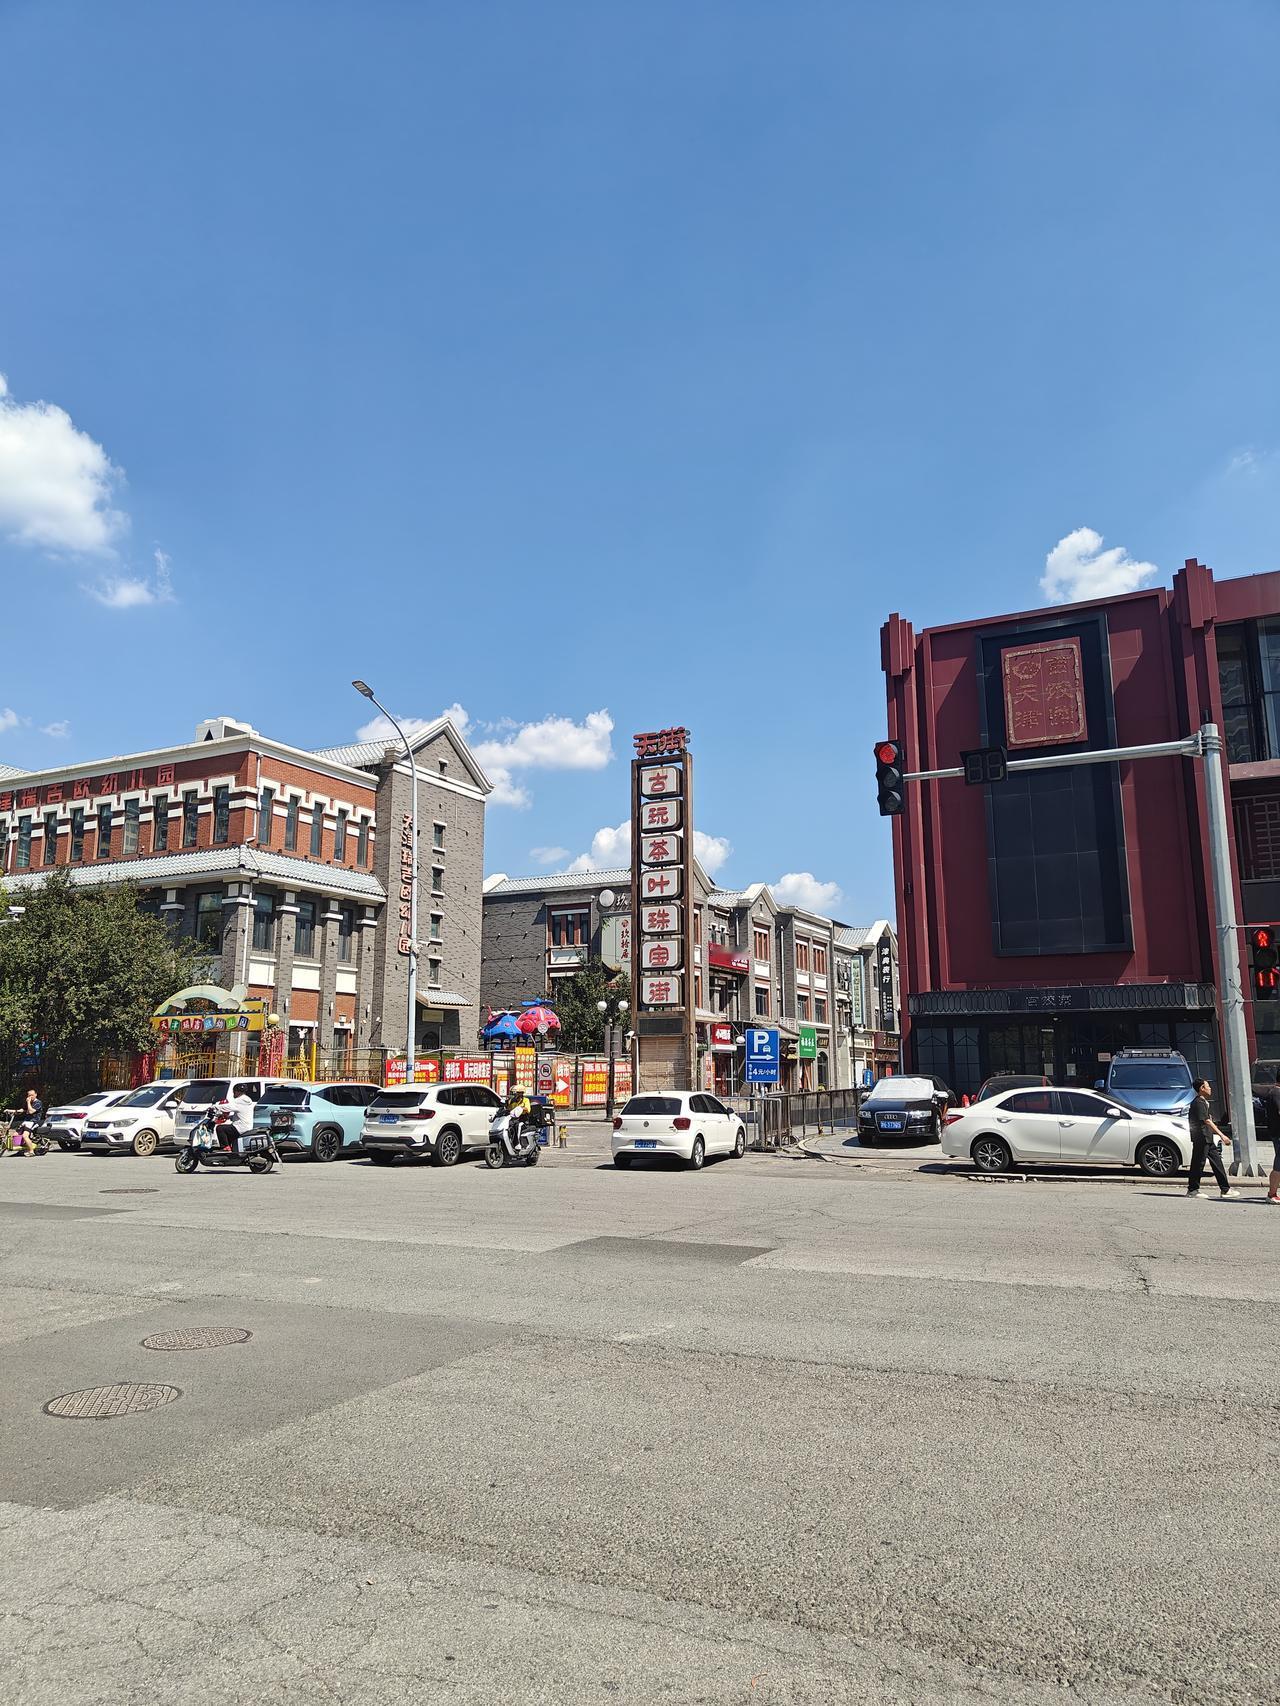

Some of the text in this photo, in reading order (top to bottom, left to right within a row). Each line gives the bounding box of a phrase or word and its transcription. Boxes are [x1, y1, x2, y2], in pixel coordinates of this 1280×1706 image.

[633, 726, 687, 756] 天街
[648, 772, 671, 1002] 古玩茶叶珠宝街
[754, 1031, 769, 1052] P
